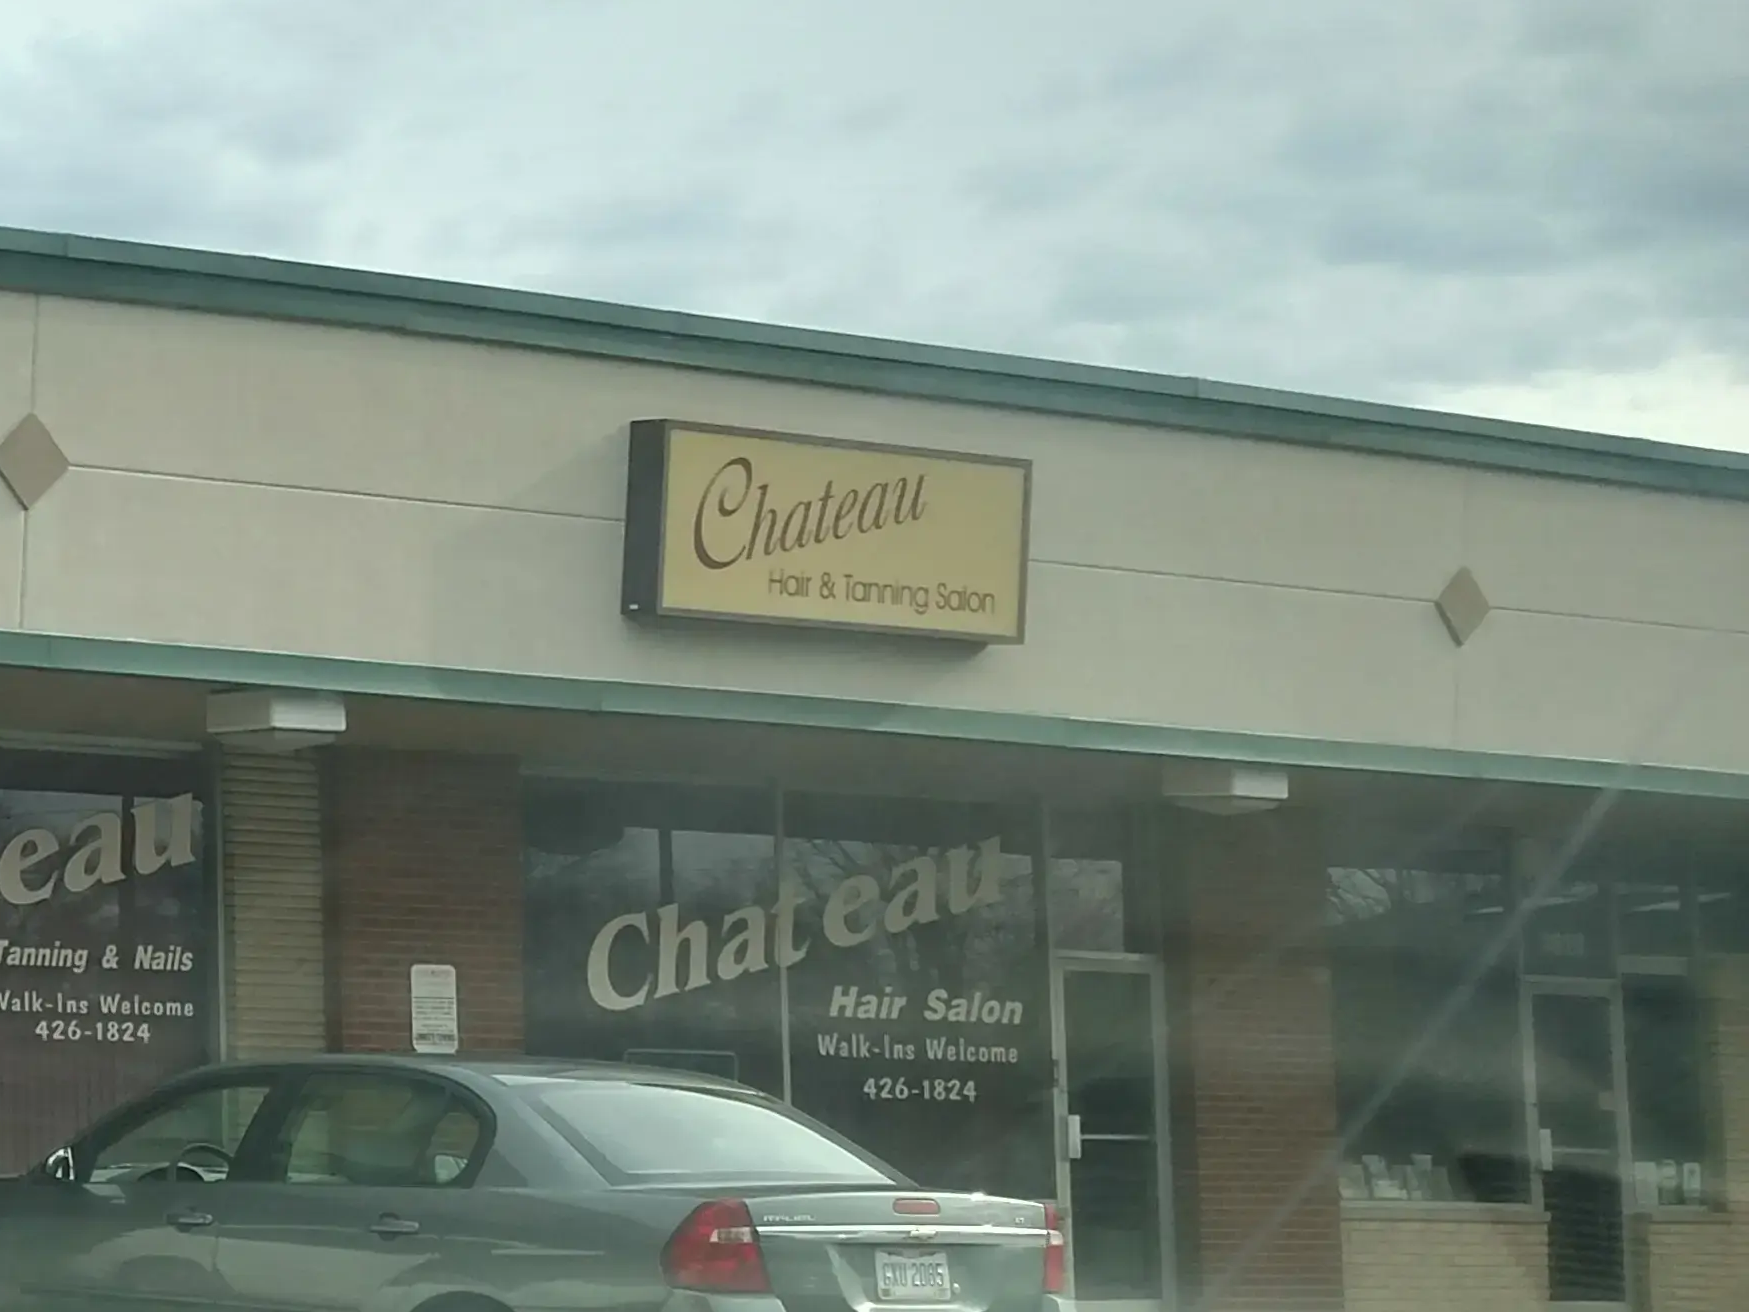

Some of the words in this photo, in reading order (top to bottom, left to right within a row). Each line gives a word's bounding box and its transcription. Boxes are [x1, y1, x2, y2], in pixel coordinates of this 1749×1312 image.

[693, 457, 928, 570] Chateau
[768, 569, 812, 599] Hair
[819, 572, 837, 600] &
[843, 574, 929, 615] Tanning
[935, 582, 995, 615] Salon
[586, 835, 1003, 1011] Chateau
[101, 944, 119, 970] &
[133, 944, 194, 971] Nails
[98, 993, 195, 1016] Welcome
[829, 985, 908, 1019] Hair
[923, 988, 1024, 1024] Salon
[34, 1019, 151, 1043] 426-1824
[817, 1032, 916, 1060] Walk-Ins
[925, 1036, 1019, 1063] Welcome
[862, 1076, 978, 1103] 426-1824
